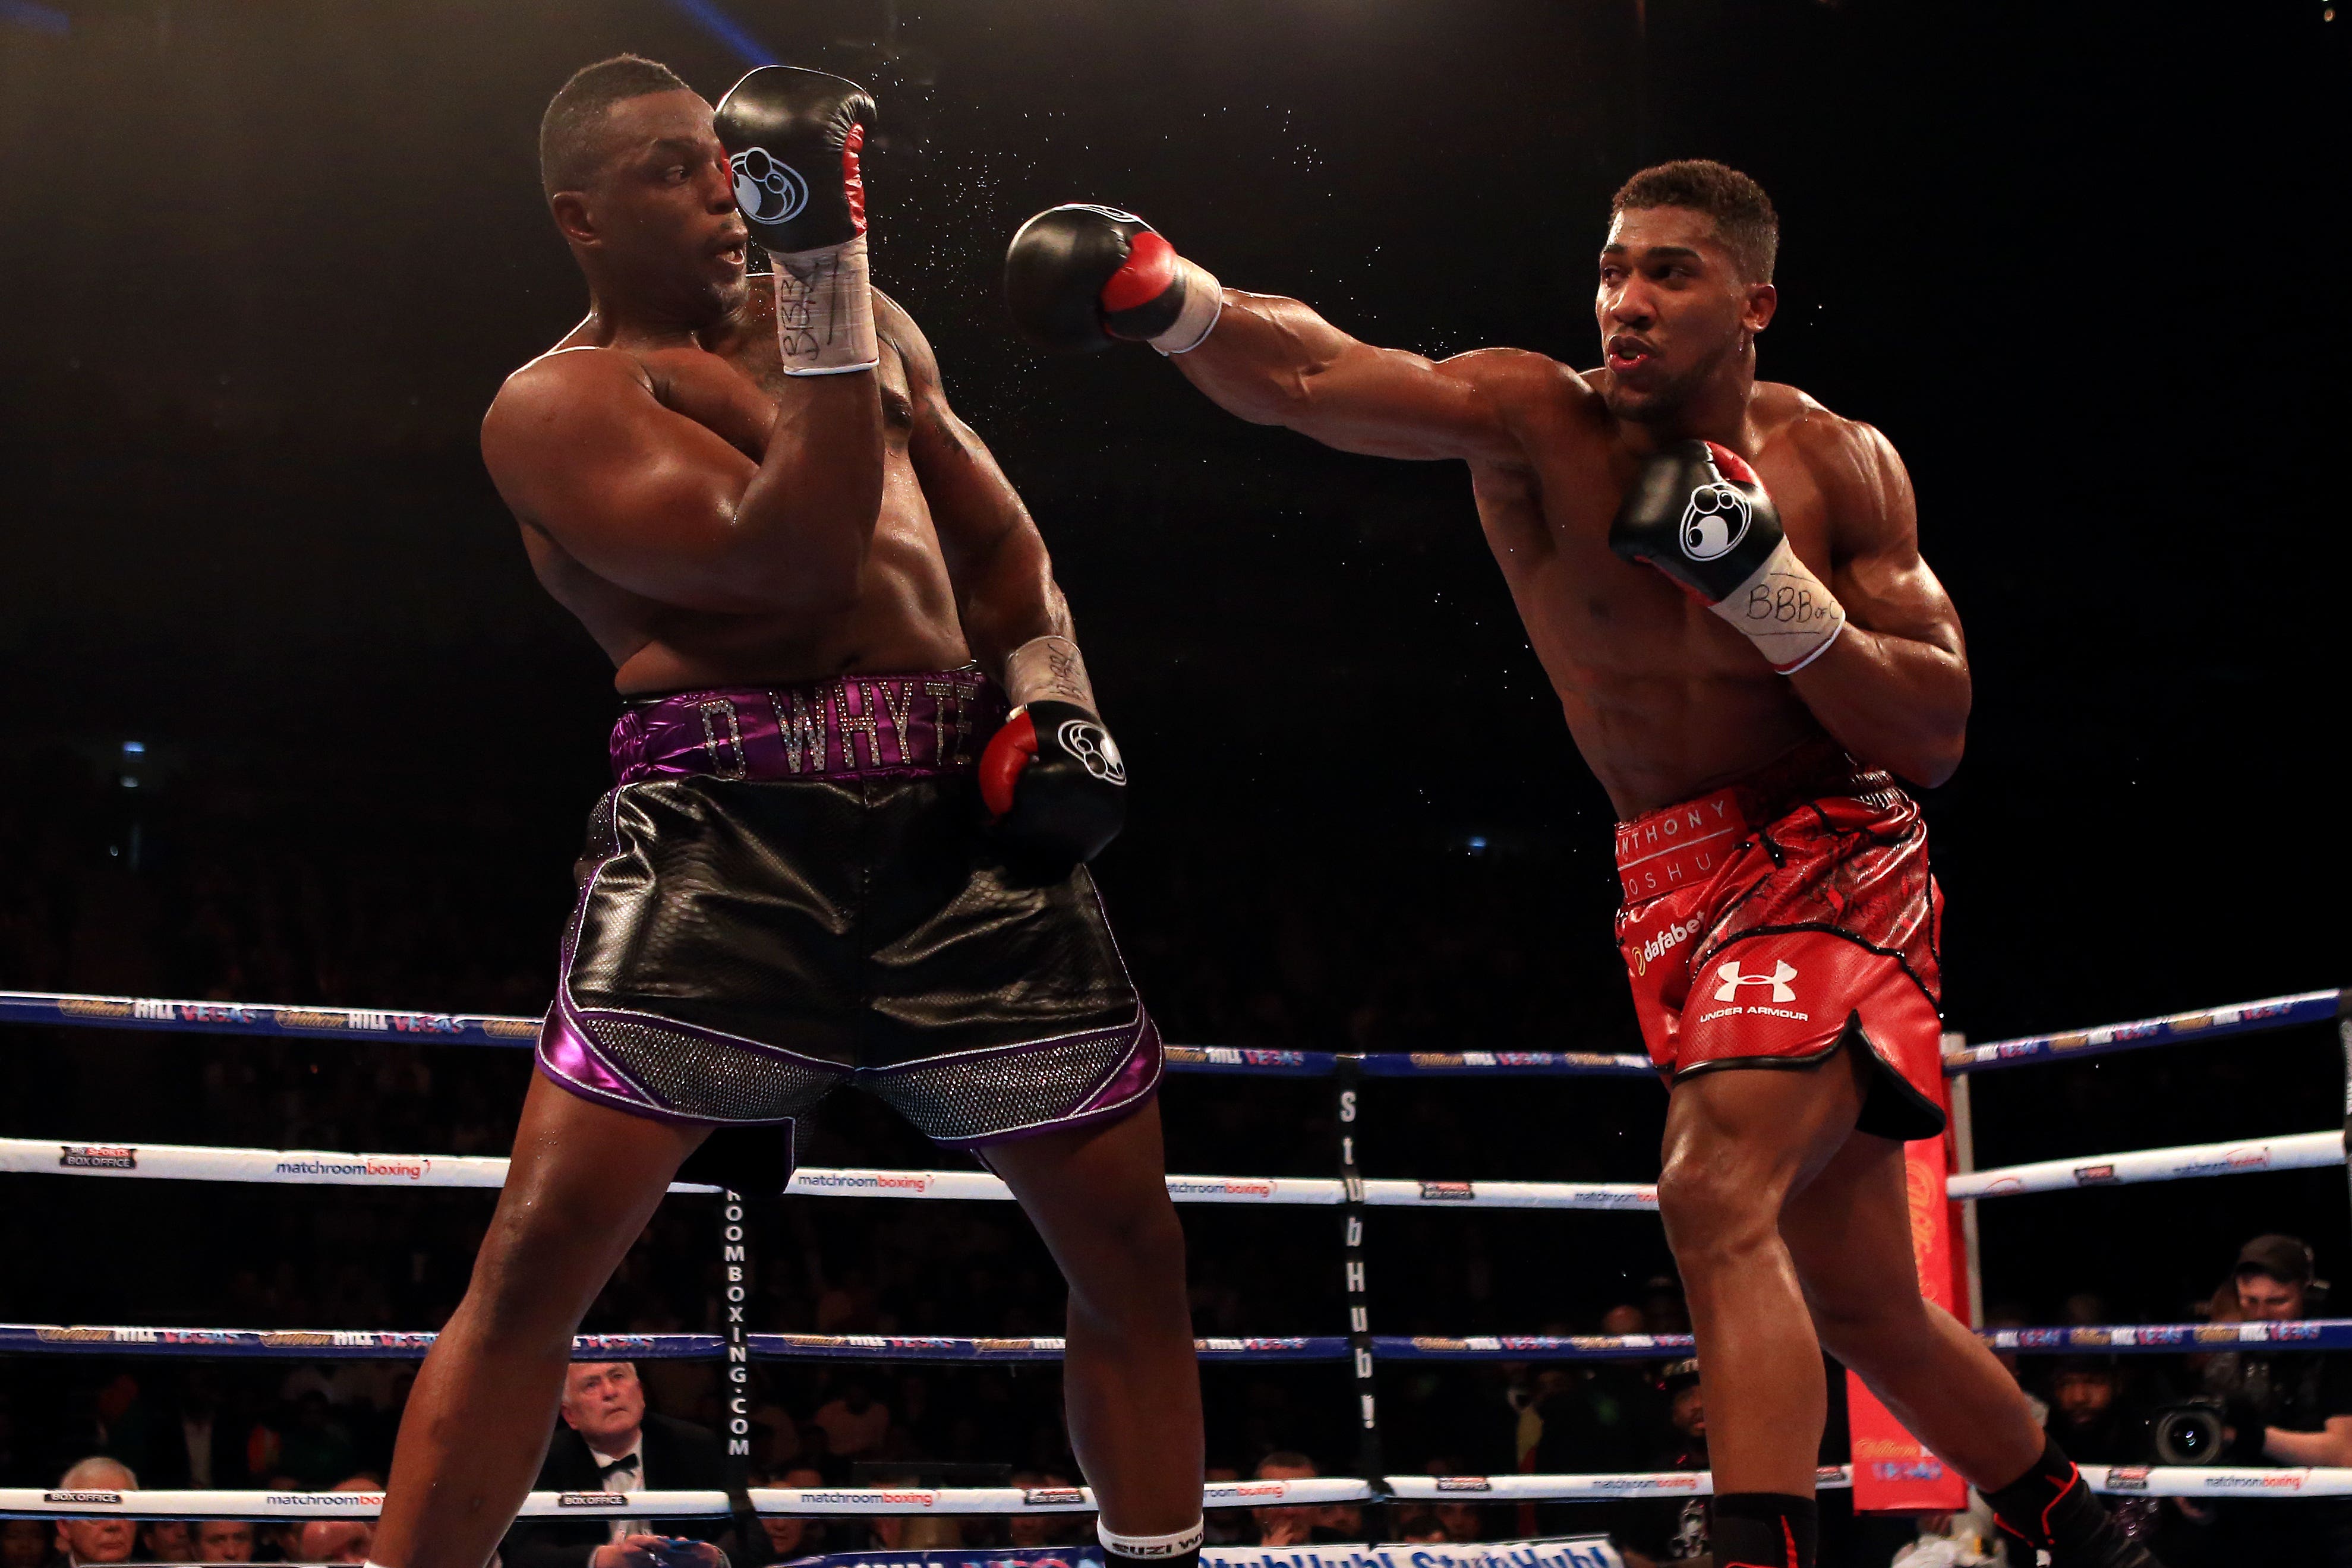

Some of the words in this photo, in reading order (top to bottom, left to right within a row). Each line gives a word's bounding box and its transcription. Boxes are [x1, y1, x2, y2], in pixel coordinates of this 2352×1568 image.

[700, 698, 747, 778] D
[768, 680, 976, 774] WHYTE
[1644, 910, 1705, 963] dafabet
[348, 1014, 389, 1031] HILL
[1700, 1007, 1743, 1023] UNDER
[1747, 1006, 1808, 1021] ARMOUR
[277, 1161, 421, 1179] matchroomboxing
[799, 1173, 925, 1192] matchroomboxing
[1166, 1182, 1270, 1198] atchroomboxing
[52, 1493, 75, 1502] BOX
[76, 1494, 117, 1503] OFFICE
[267, 1496, 384, 1506] matchroombo
[564, 1497, 586, 1505] BOX
[801, 1492, 932, 1507] matchroomboxing
[1112, 1544, 1173, 1556] SUZI
